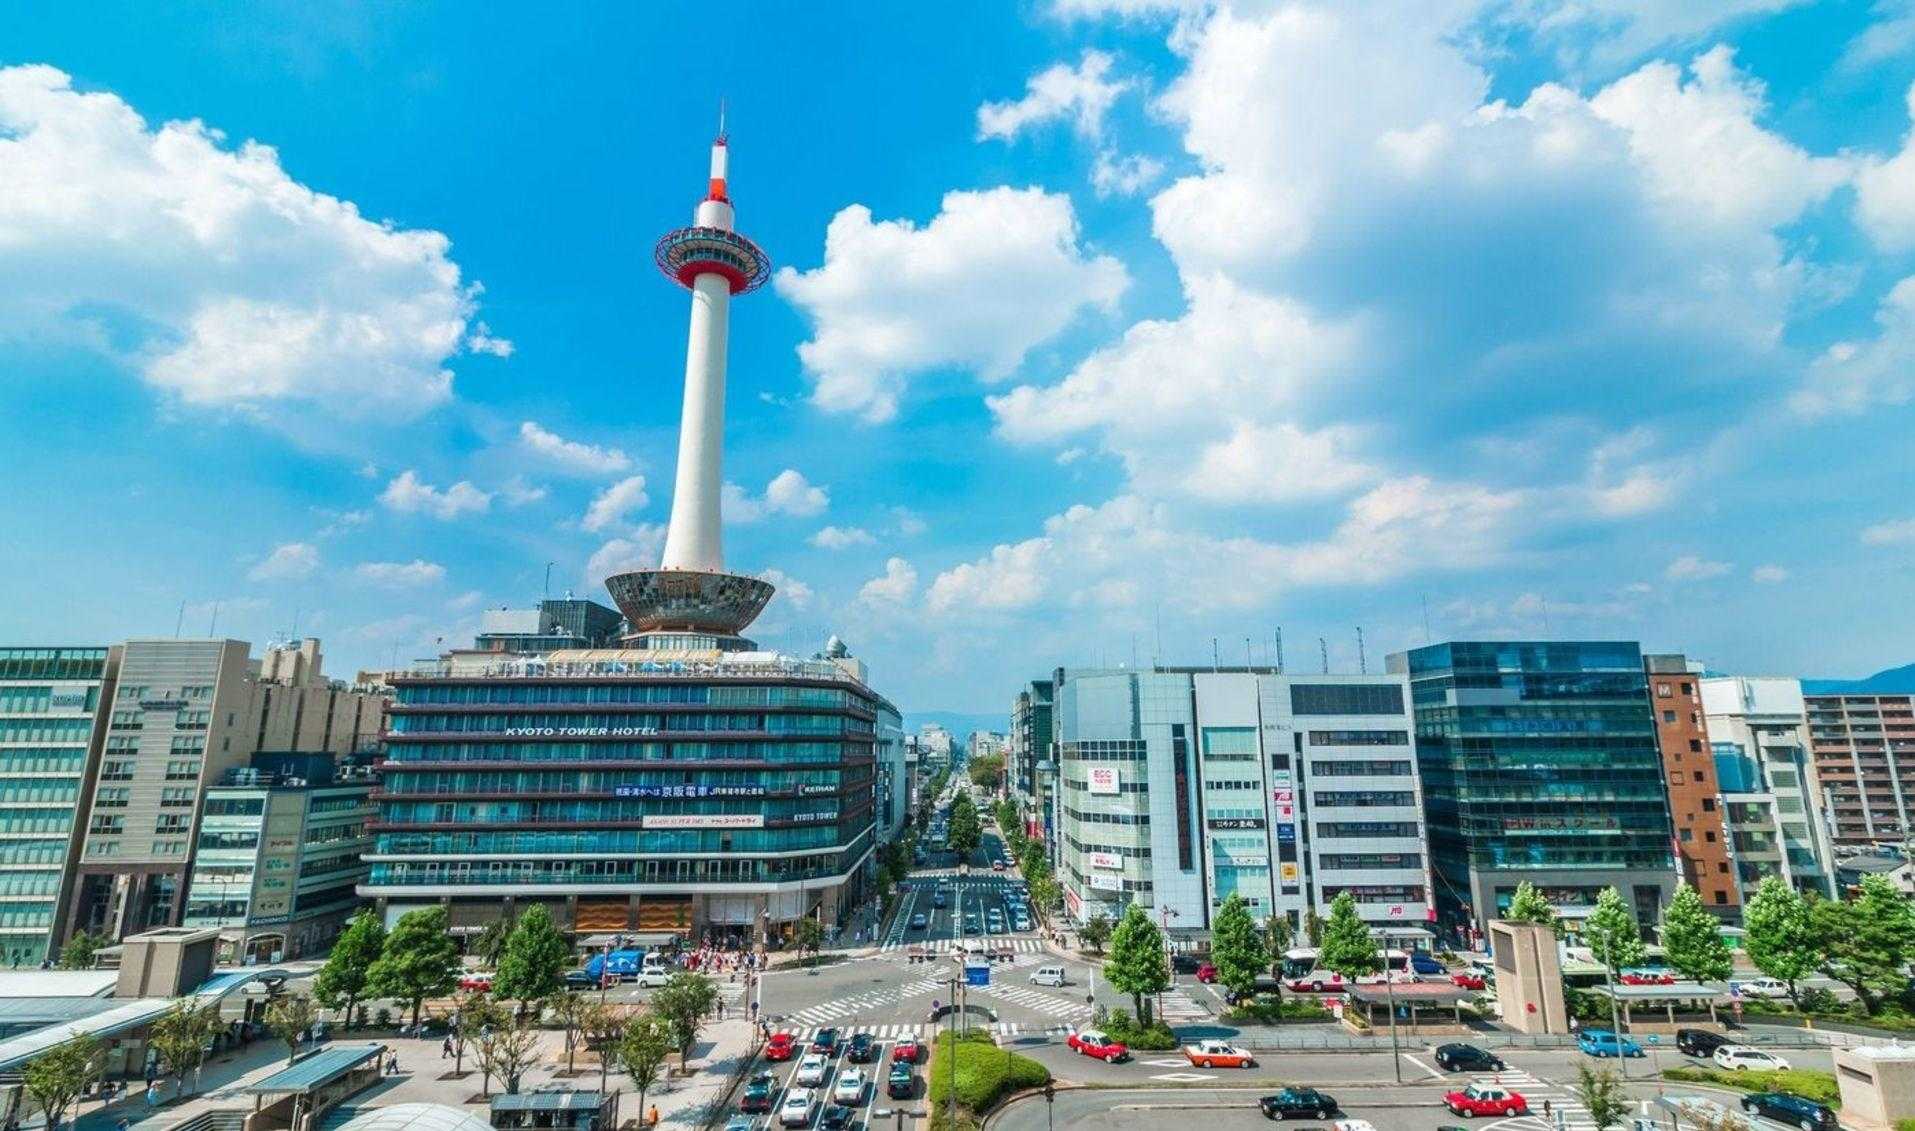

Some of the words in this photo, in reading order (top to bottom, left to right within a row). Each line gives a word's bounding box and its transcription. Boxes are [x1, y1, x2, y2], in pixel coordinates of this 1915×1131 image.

[505, 727, 554, 736] KYOTO
[559, 727, 608, 736] TOWER
[612, 727, 658, 736] HOTEL
[1094, 769, 1111, 777] ECC
[793, 813, 815, 822] KYOTO
[816, 812, 838, 821] TOWER
